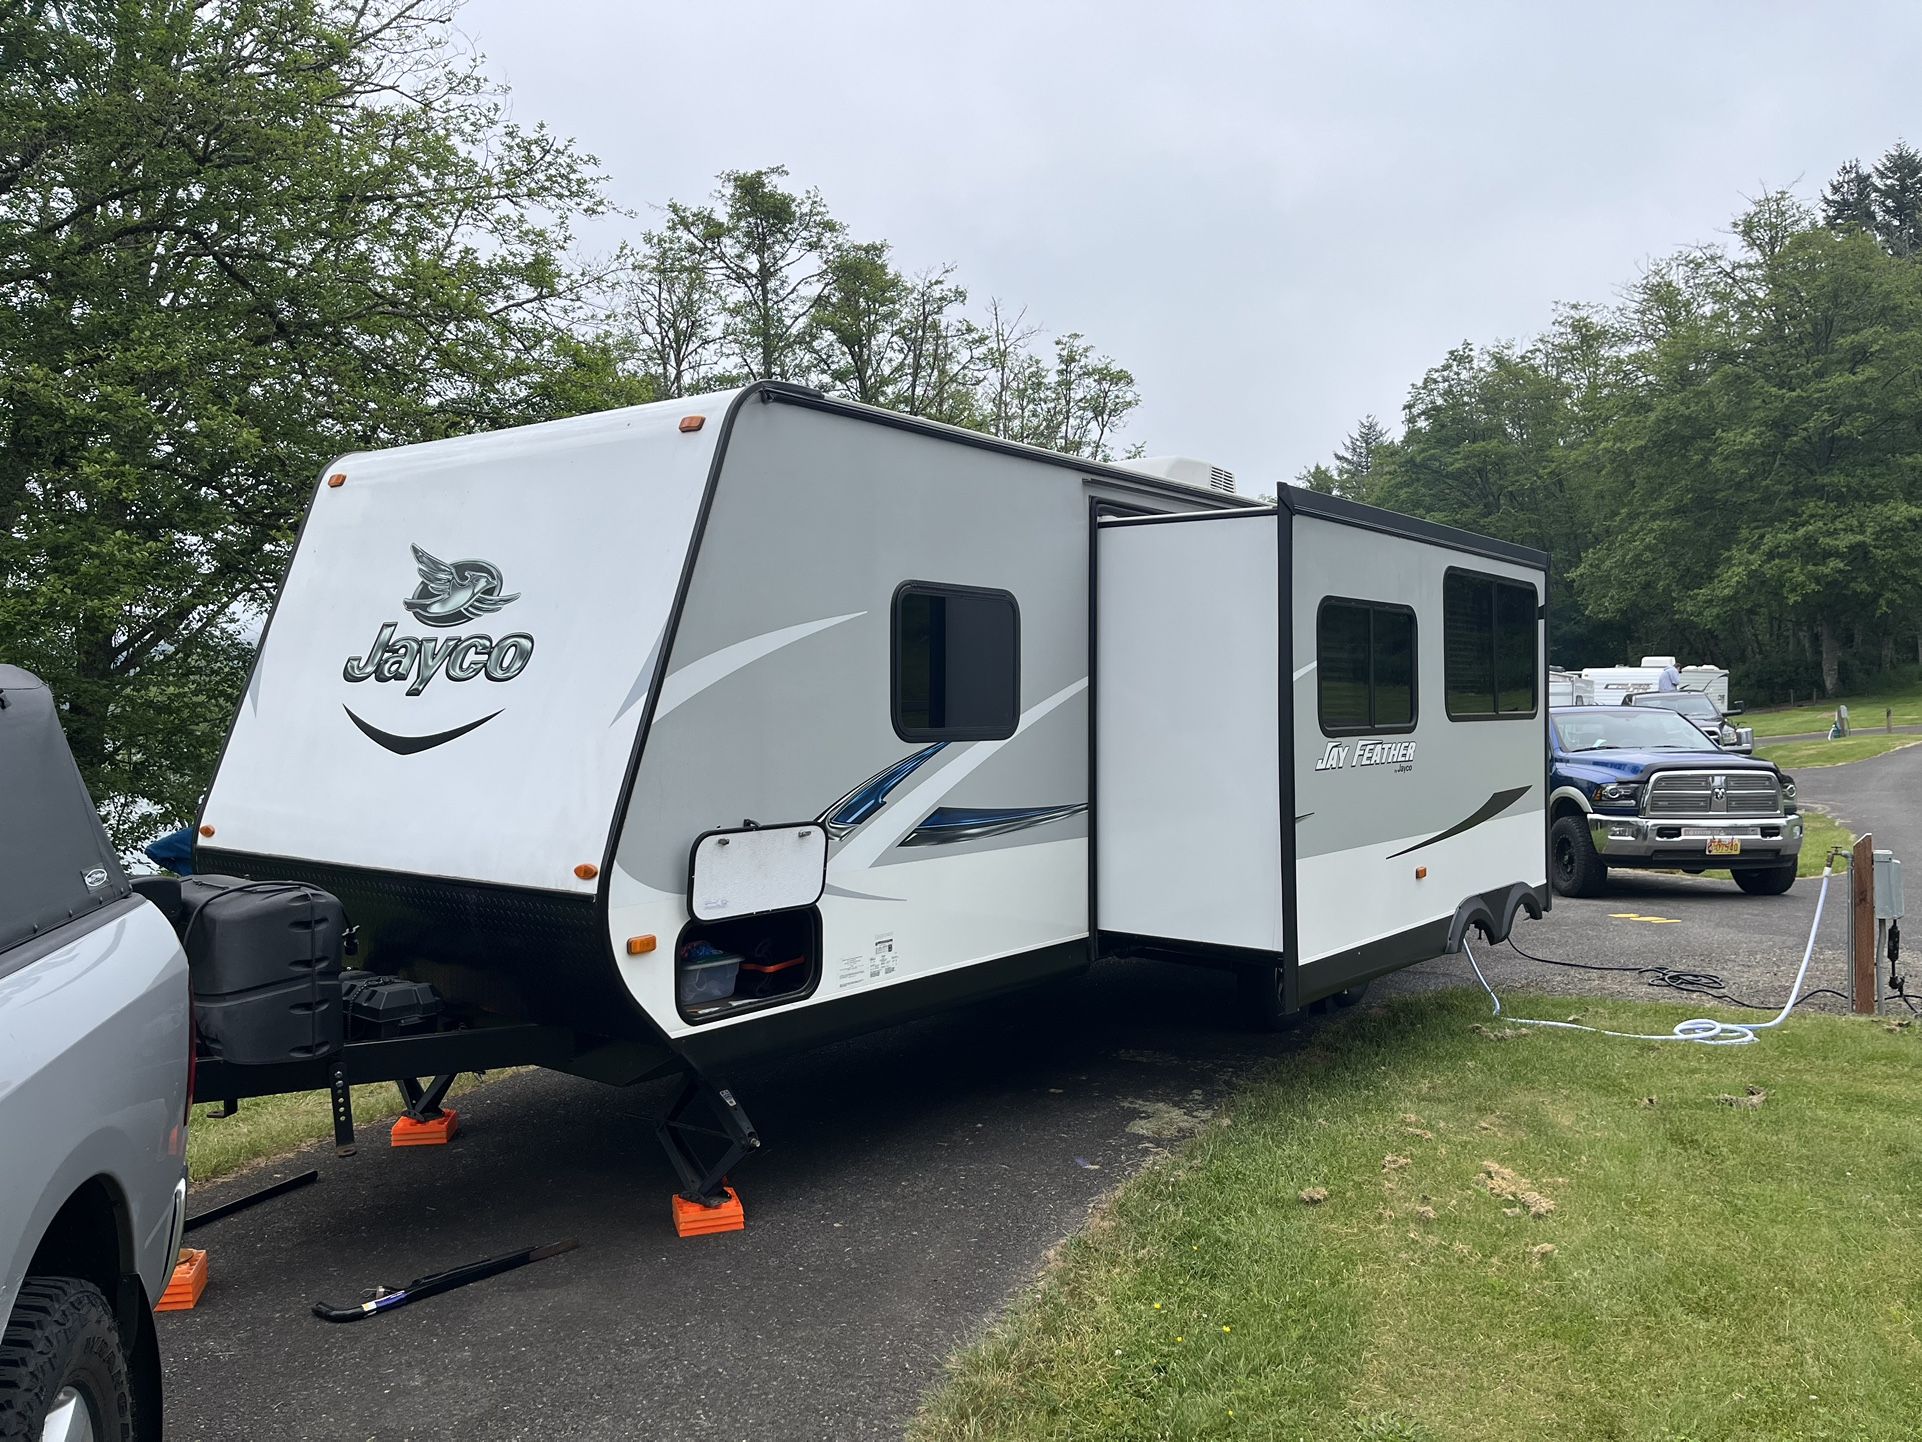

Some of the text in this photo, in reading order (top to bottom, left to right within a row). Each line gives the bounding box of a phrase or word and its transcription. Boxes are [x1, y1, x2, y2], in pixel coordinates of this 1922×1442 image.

[343, 621, 535, 696] Jayco
[1315, 739, 1416, 771] JAY FEATHER
